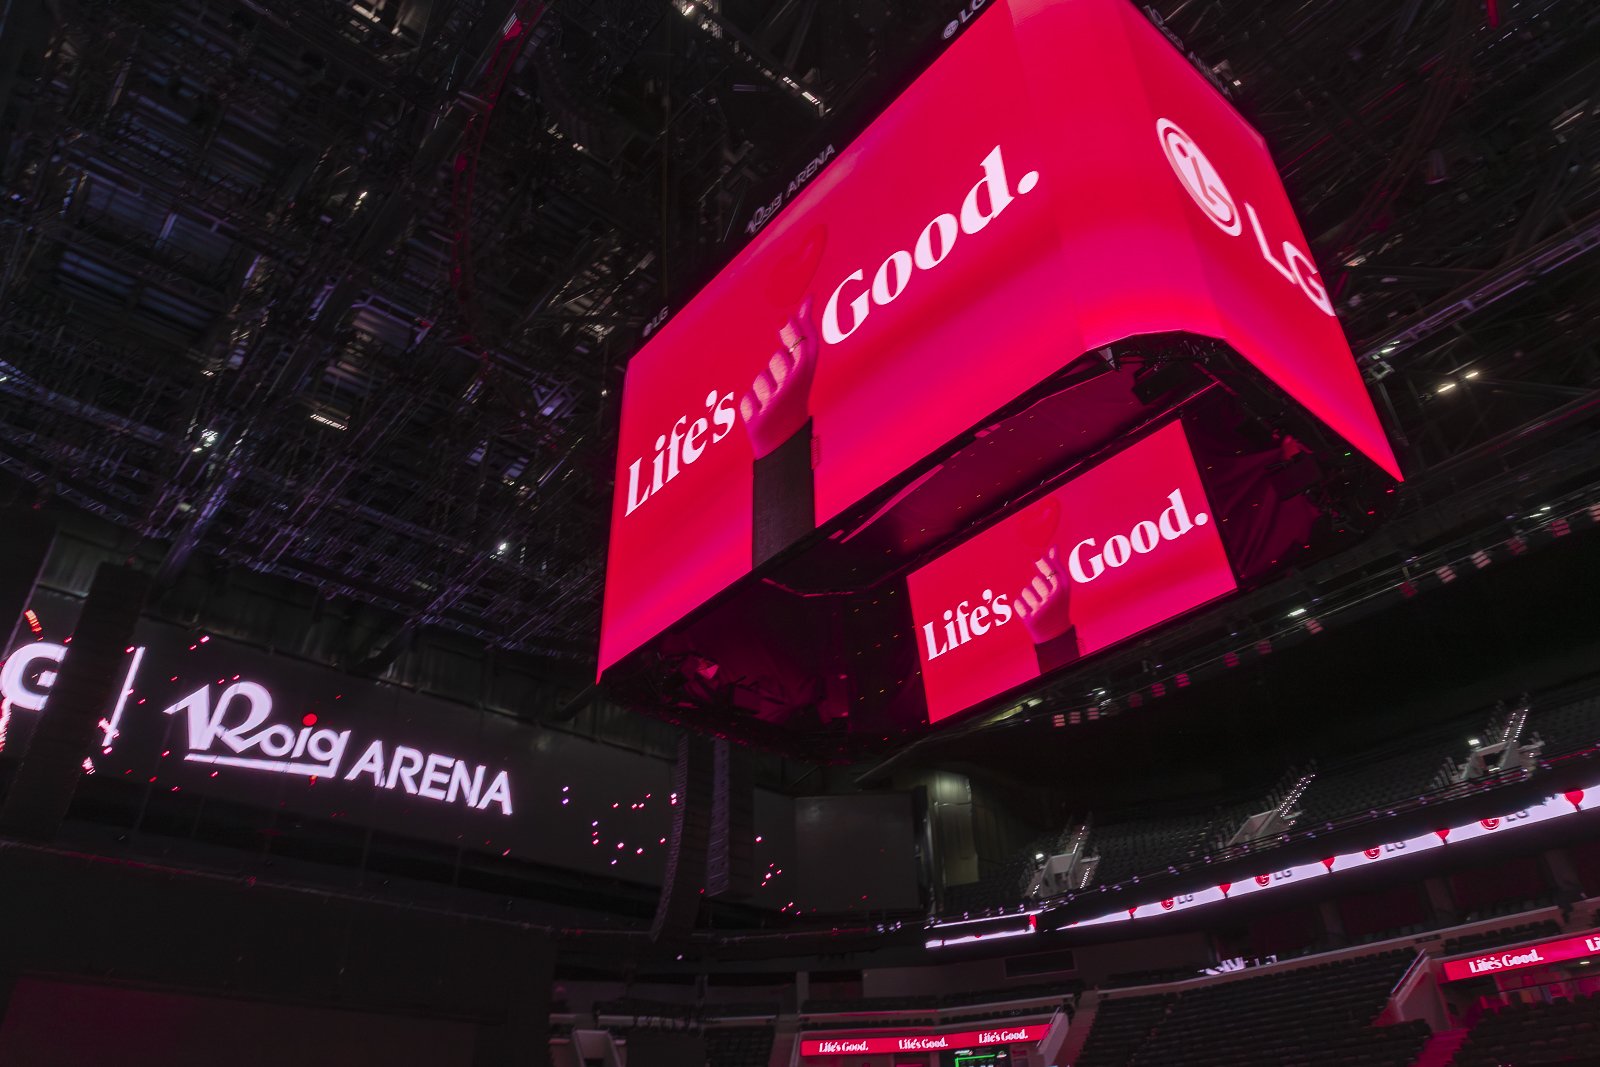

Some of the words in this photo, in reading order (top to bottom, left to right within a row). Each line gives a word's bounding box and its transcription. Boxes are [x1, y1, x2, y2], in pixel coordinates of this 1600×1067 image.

[785, 144, 836, 199] ARENA
[1244, 200, 1337, 317] LG
[624, 389, 736, 518] Life's
[821, 144, 1040, 345] Good.
[922, 588, 1013, 662] Life's
[1068, 487, 1209, 584] Good.
[162, 681, 352, 779] Roig
[343, 739, 514, 816] ARENA
[1501, 948, 1544, 967] Good.
[841, 1040, 869, 1052] Good.
[921, 1036, 949, 1049] Good.
[1000, 1028, 1029, 1042] Good.
